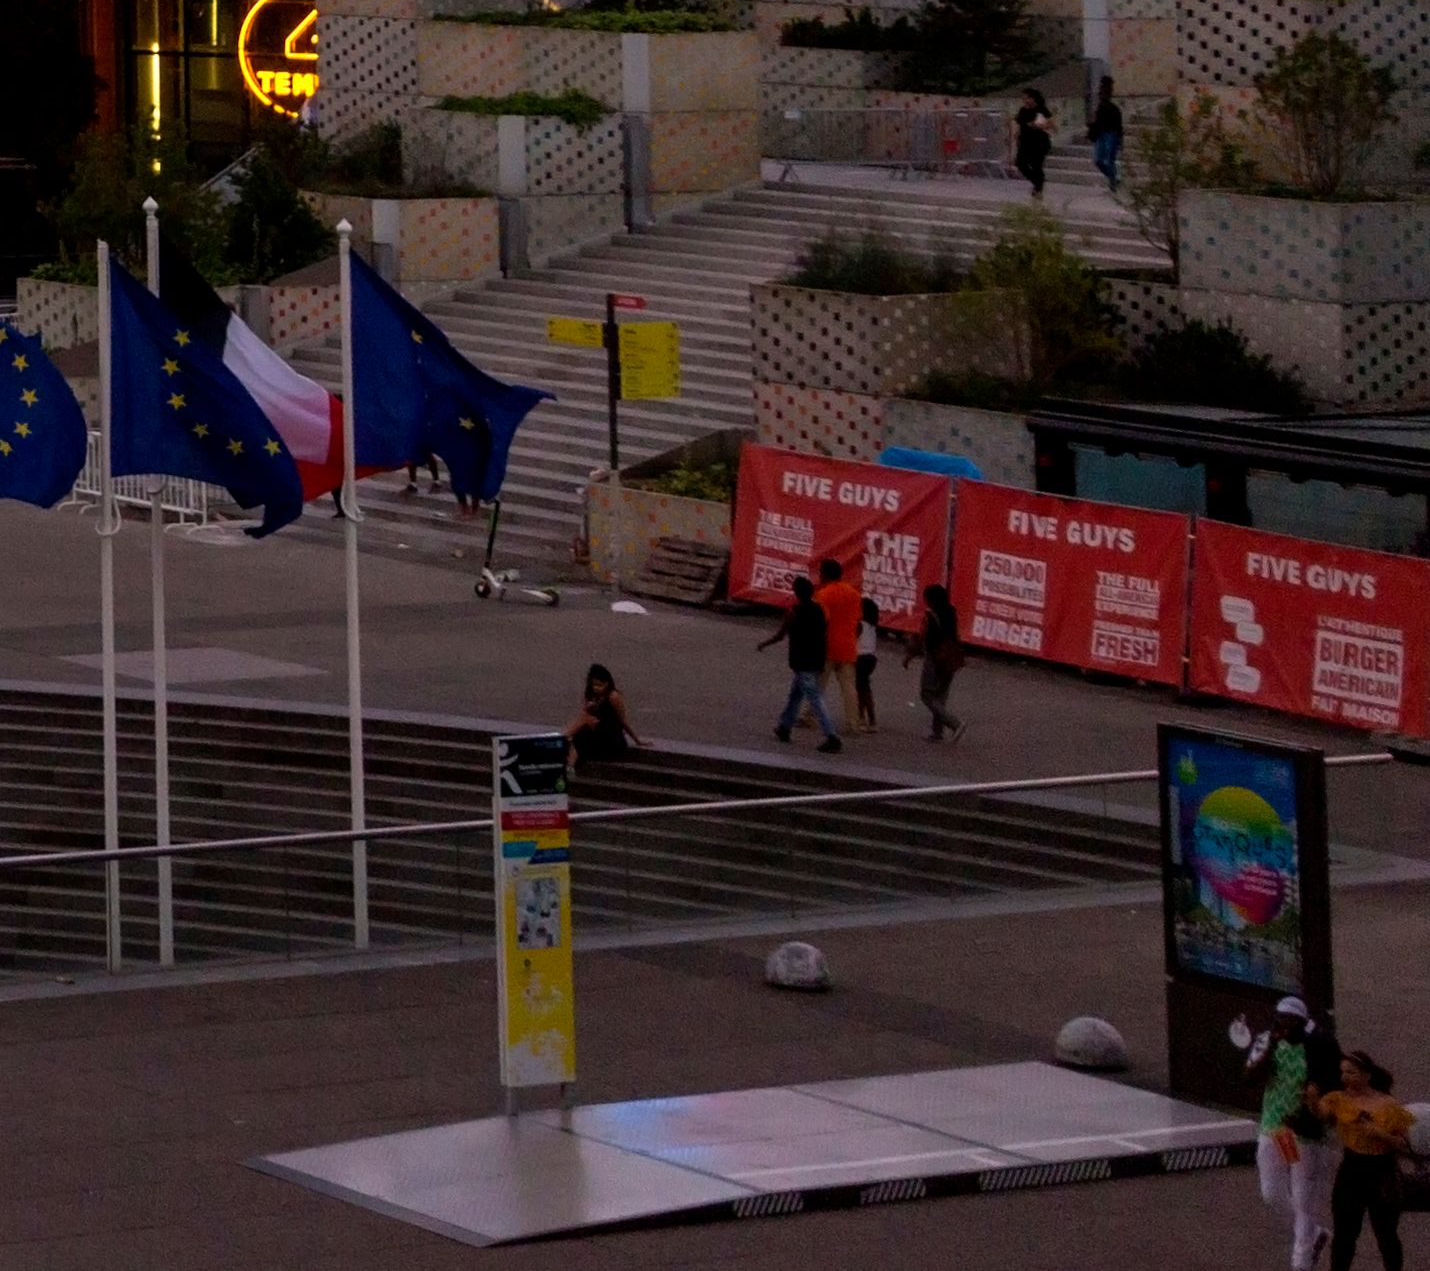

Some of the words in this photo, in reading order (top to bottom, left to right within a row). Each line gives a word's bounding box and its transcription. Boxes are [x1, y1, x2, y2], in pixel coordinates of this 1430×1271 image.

[256, 70, 319, 97] TEM
[782, 470, 833, 502] FIVE
[838, 480, 902, 513] GUYS
[865, 531, 920, 562] THE
[1008, 509, 1059, 541] FIVE
[1066, 520, 1136, 554] GUYS
[1096, 570, 1125, 587] THE
[1127, 574, 1160, 592] FULL
[1246, 551, 1302, 586] FIVE
[1306, 564, 1378, 600] GUYS
[861, 591, 916, 616] RAFT
[972, 615, 1043, 652] BURGER
[1094, 633, 1158, 665] FRESH
[1320, 637, 1399, 677] BURGER
